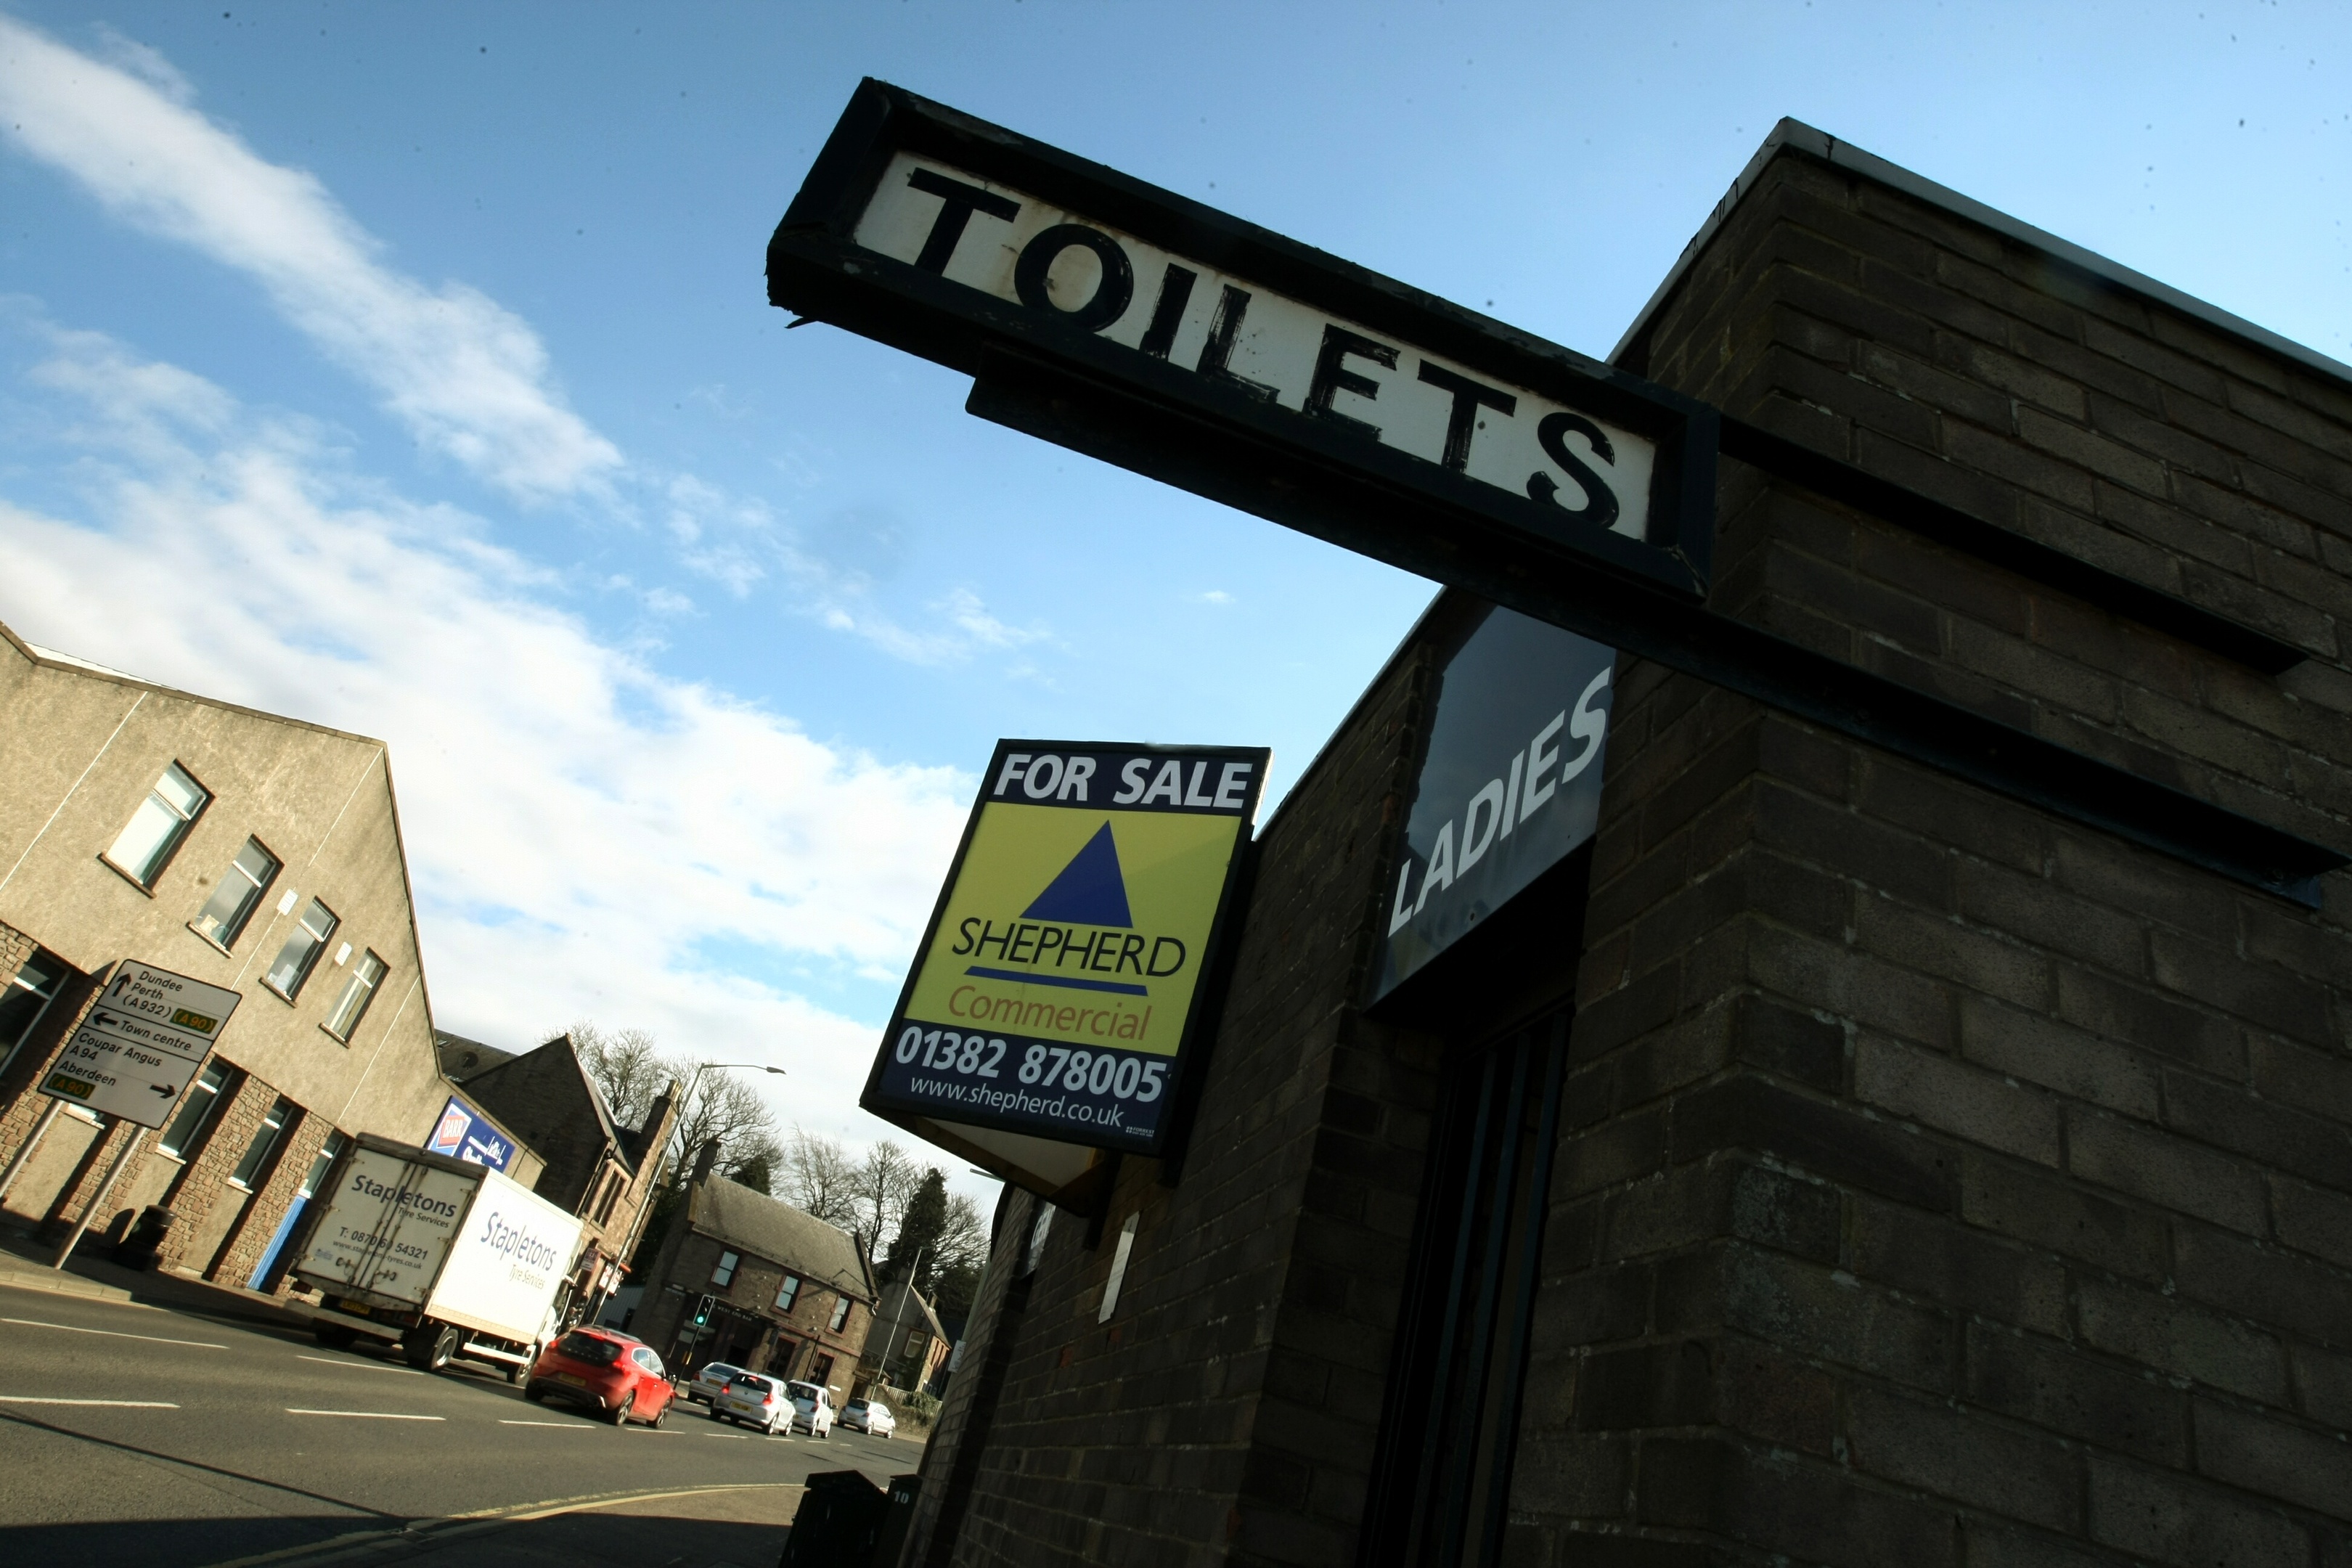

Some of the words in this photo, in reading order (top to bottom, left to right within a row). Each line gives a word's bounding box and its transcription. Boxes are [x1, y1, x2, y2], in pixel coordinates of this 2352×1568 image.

[909, 166, 1620, 531] TOILETS
[992, 754, 1096, 801] FOR
[1113, 759, 1252, 809] SALE
[1388, 666, 1611, 938] LADIES
[952, 917, 1186, 977] SHEPHERD
[131, 982, 163, 1000] Perth
[139, 971, 183, 992] Dundee
[949, 985, 1152, 1041] Commercial
[78, 1032, 122, 1053] Coupar
[123, 1048, 163, 1067] Angus
[121, 1020, 150, 1038] Town
[153, 1033, 192, 1051] centre
[59, 1061, 116, 1086] Aberdeen
[896, 1026, 1007, 1078] 01382
[1018, 1045, 1167, 1103] 878005
[910, 1077, 1124, 1127] www.shepherd.co.uk
[442, 1119, 464, 1138] BARR
[351, 1174, 457, 1217] Stapletons
[398, 1206, 415, 1219] Tyre
[416, 1213, 449, 1228] Services
[340, 1226, 349, 1238] T:
[395, 1243, 428, 1259] 54321
[480, 1212, 557, 1271] Stapletons
[510, 1264, 523, 1281] Tyre
[522, 1270, 546, 1289] Services
[894, 1490, 910, 1504] 10
